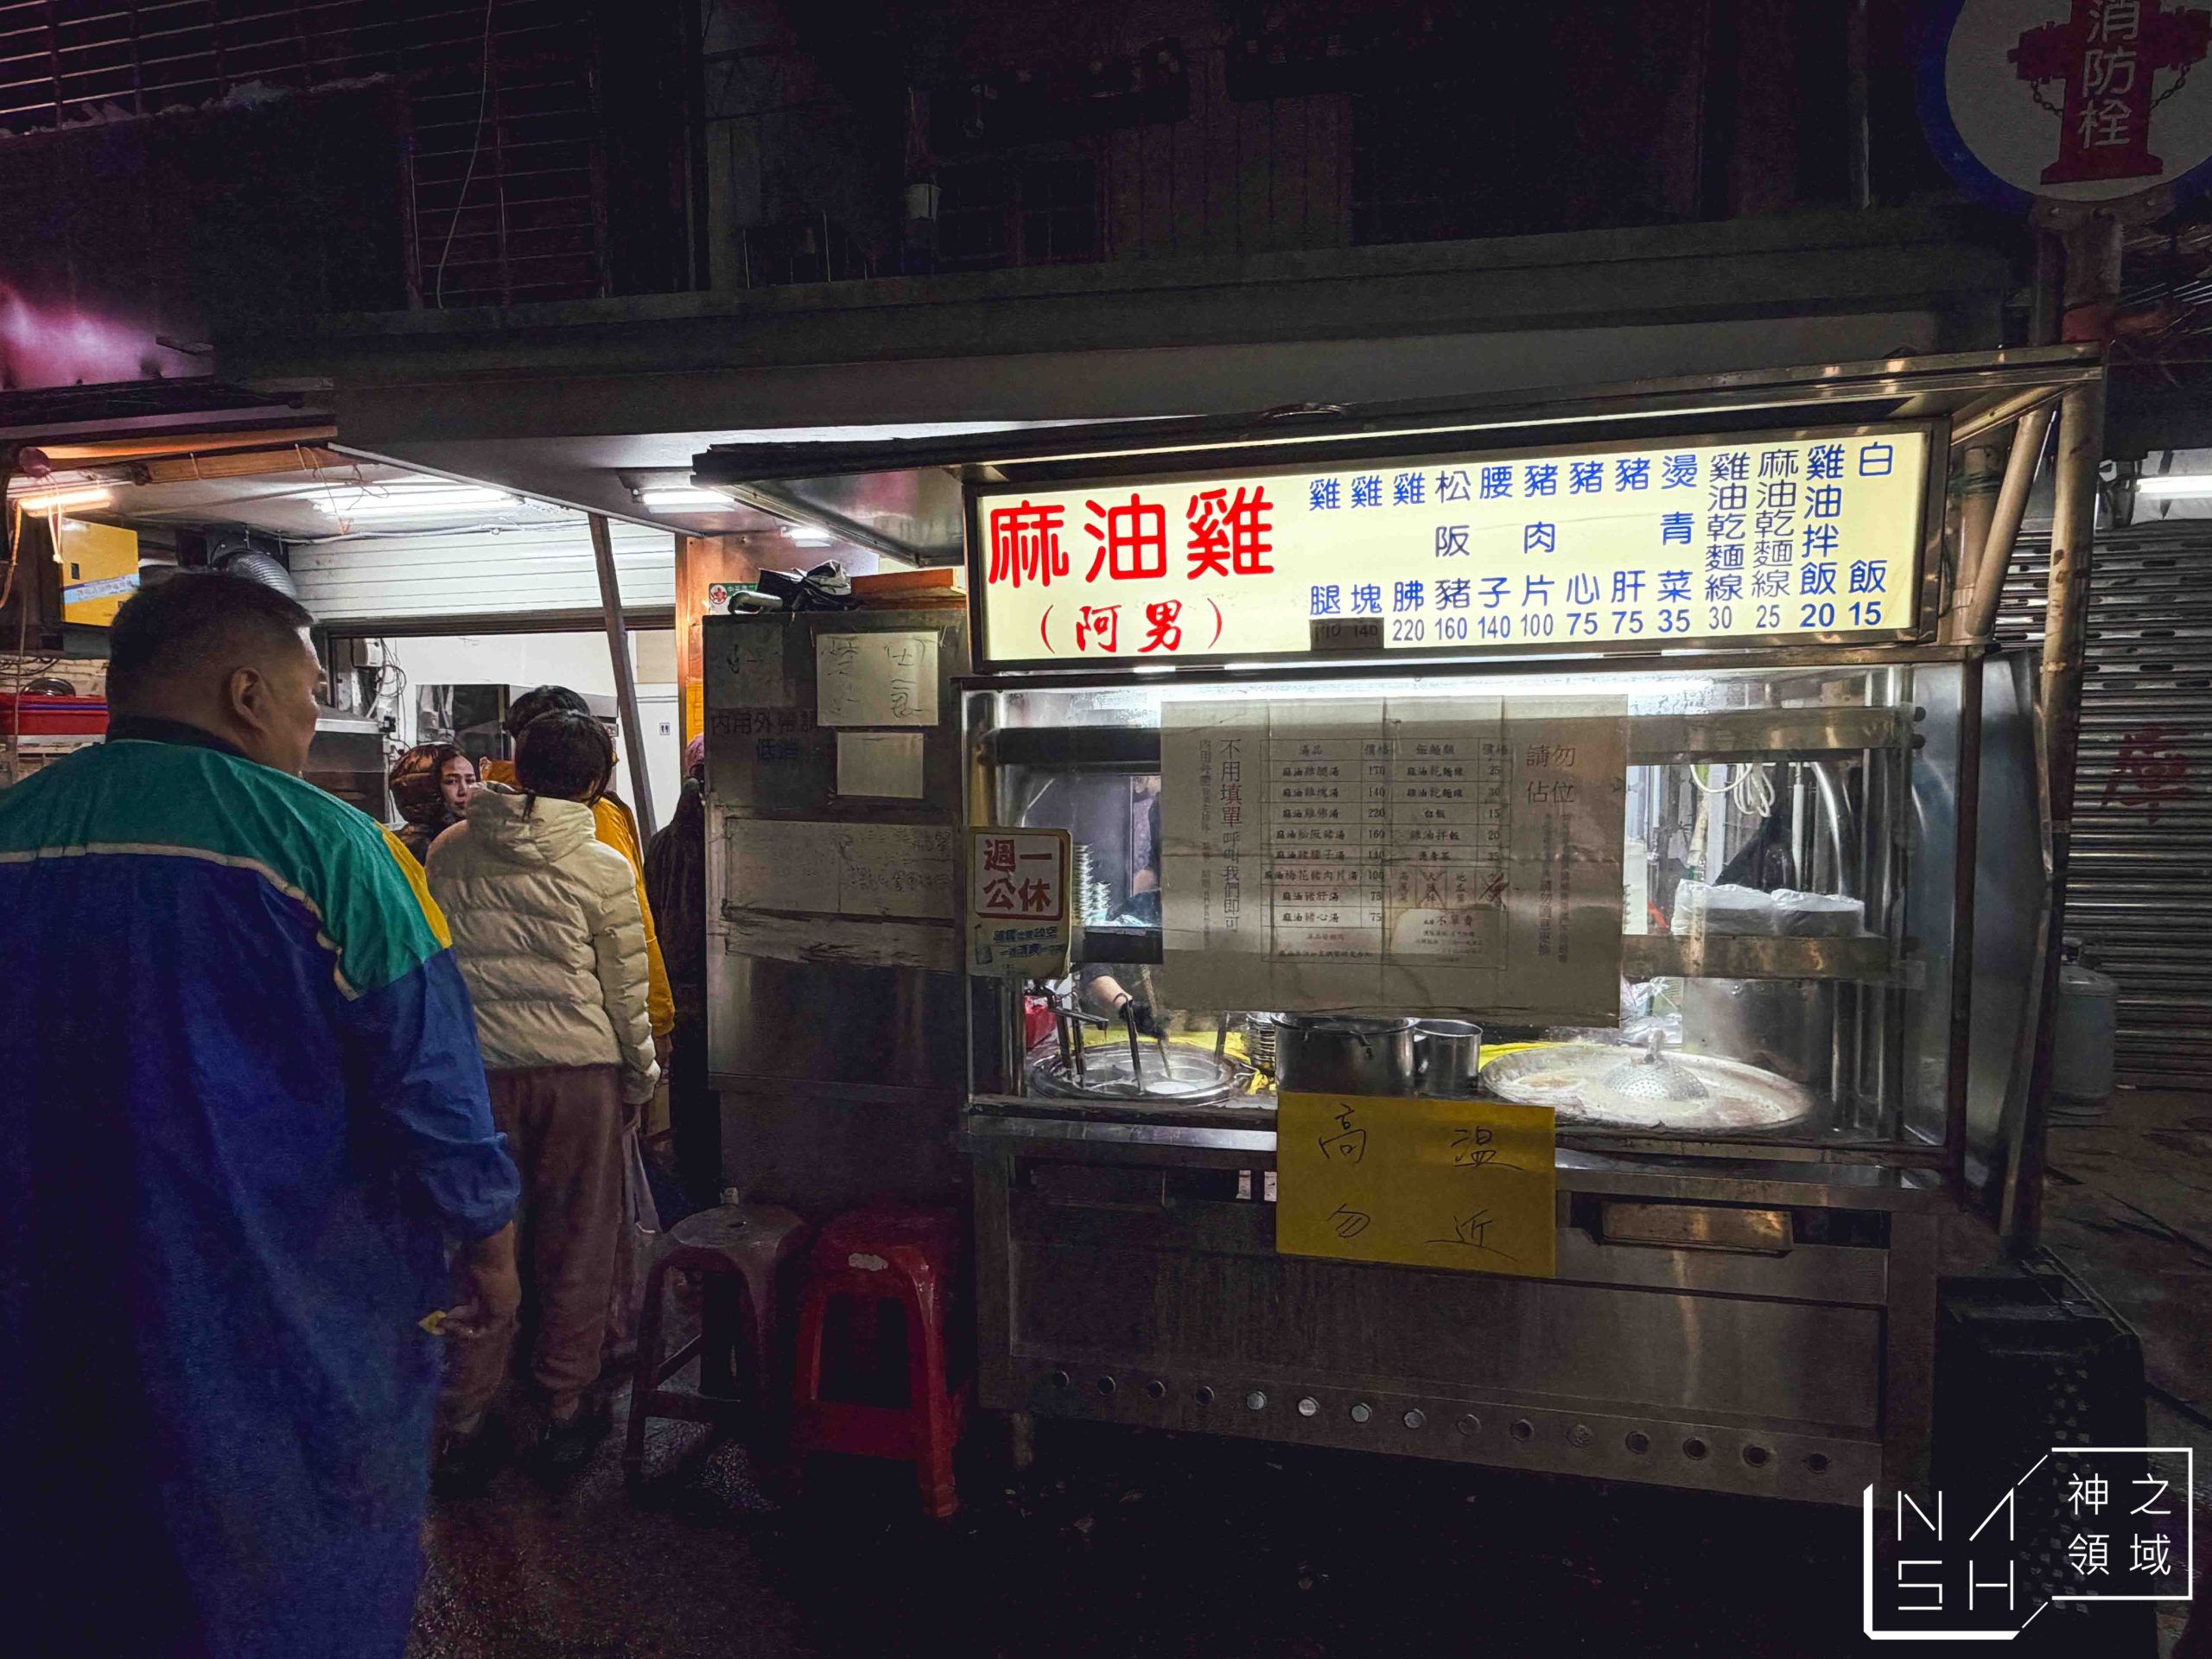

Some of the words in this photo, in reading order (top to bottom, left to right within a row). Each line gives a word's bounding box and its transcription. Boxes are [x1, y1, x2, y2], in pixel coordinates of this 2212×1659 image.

[2078, 0, 2140, 149] 消防栓
[1611, 457, 1651, 603] 豬肝
[1657, 454, 1698, 603] 燙青菜
[1704, 452, 1751, 602] 雞油乾麵線
[1751, 448, 1799, 598] 麻油乾麵線
[1799, 444, 1847, 596] 雞油拌飯
[1849, 441, 1894, 594] 白飯
[988, 486, 1274, 588] 麻油雞
[1351, 474, 1382, 614] 雞塊
[1434, 470, 1471, 610] 松阪豬
[1478, 465, 1513, 608] 腰子
[1522, 463, 1559, 607] 豬肉片
[1566, 461, 1604, 606] 豬心
[1309, 478, 1341, 616] 雞腿
[1521, 613, 1554, 637] 100
[1566, 612, 1599, 636] 75
[1611, 610, 1643, 635] 75
[1657, 608, 1691, 633] 35
[1708, 606, 1732, 630] 30
[1756, 604, 1780, 629] 25
[1799, 603, 1836, 629] 20
[1848, 601, 1883, 626] 15
[1392, 619, 1425, 641] 220
[1434, 617, 1468, 640] 160
[1478, 615, 1510, 639] 140
[1527, 744, 1577, 767] 請勿
[1488, 787, 1501, 797] 30
[1528, 780, 1575, 804] 佔位
[1368, 808, 1386, 818] 220
[1489, 808, 1501, 819] 15
[1368, 829, 1385, 839] 160
[1487, 830, 1501, 841] 20
[982, 839, 1054, 873] 週一
[982, 877, 1052, 912] 公休
[1326, 1204, 1518, 1262] 勿近
